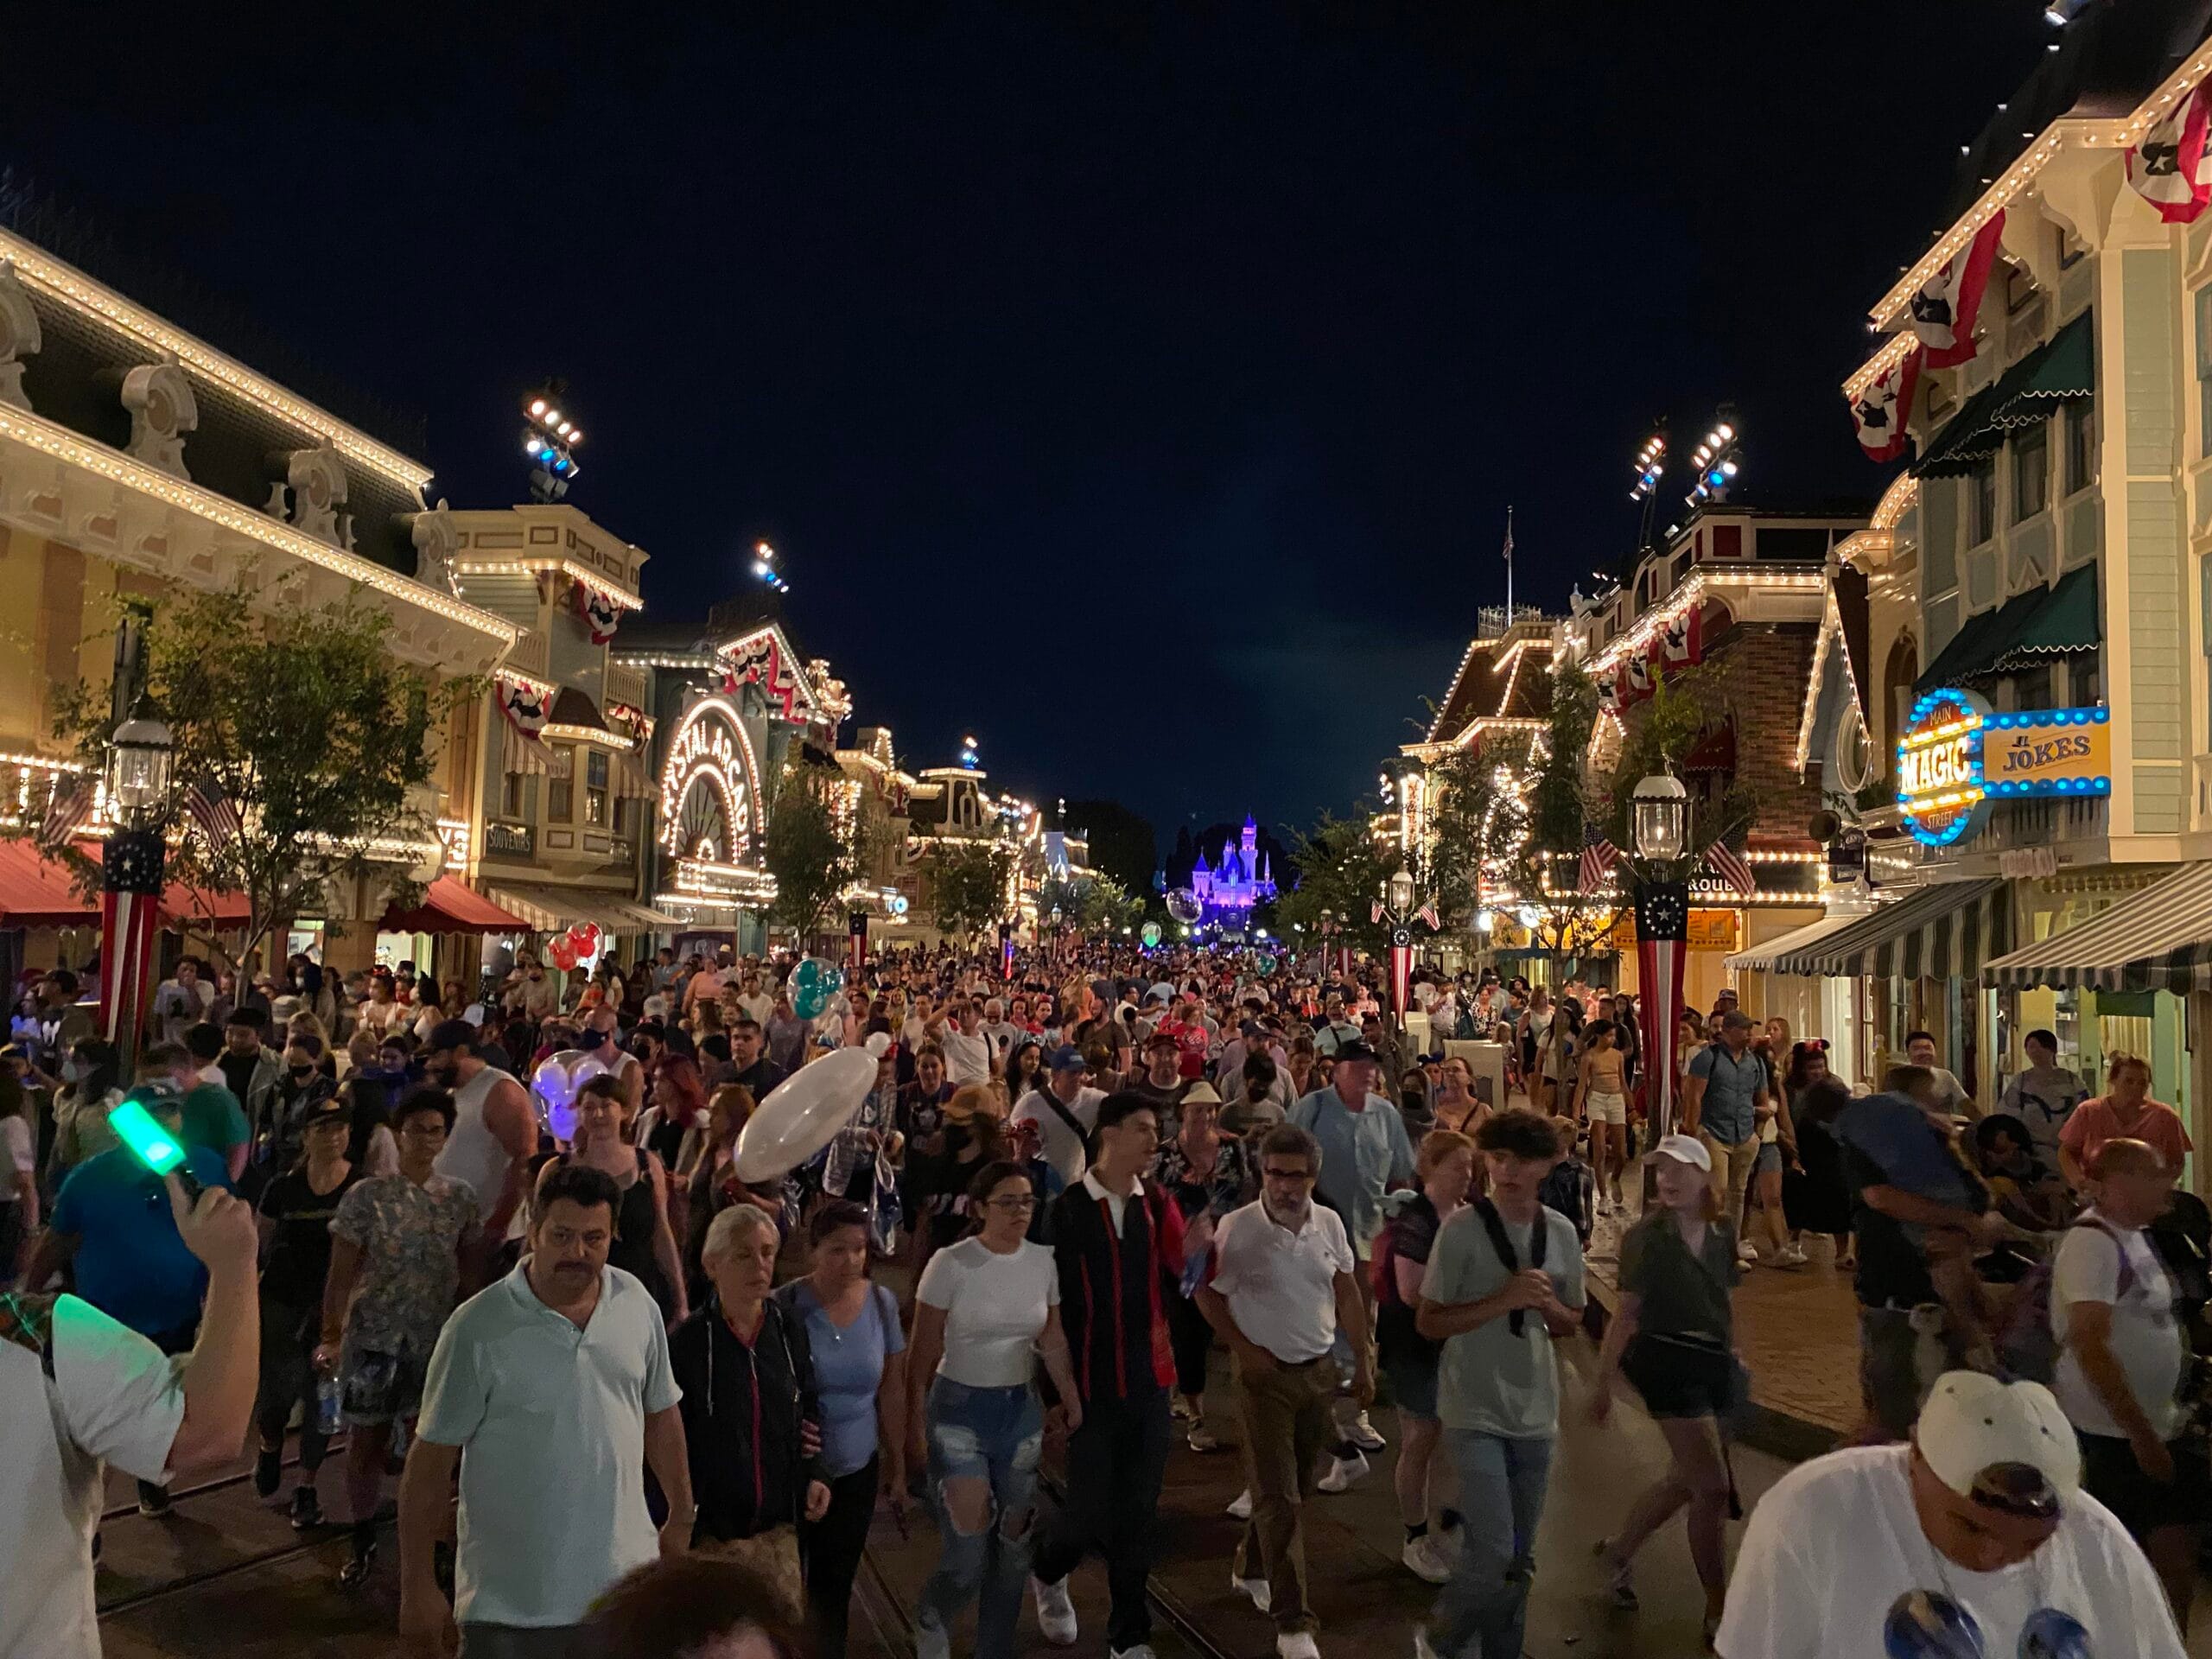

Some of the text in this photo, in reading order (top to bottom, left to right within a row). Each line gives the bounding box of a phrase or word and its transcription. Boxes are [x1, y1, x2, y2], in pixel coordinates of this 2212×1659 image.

[1929, 705, 1952, 727] MAIN
[1901, 736, 1970, 795] MAGIC
[2002, 735, 2091, 772] JOKES
[711, 726, 751, 857] ARCADE
[1927, 810, 1954, 830] STREET
[488, 829, 531, 852] SOUVENIRS
